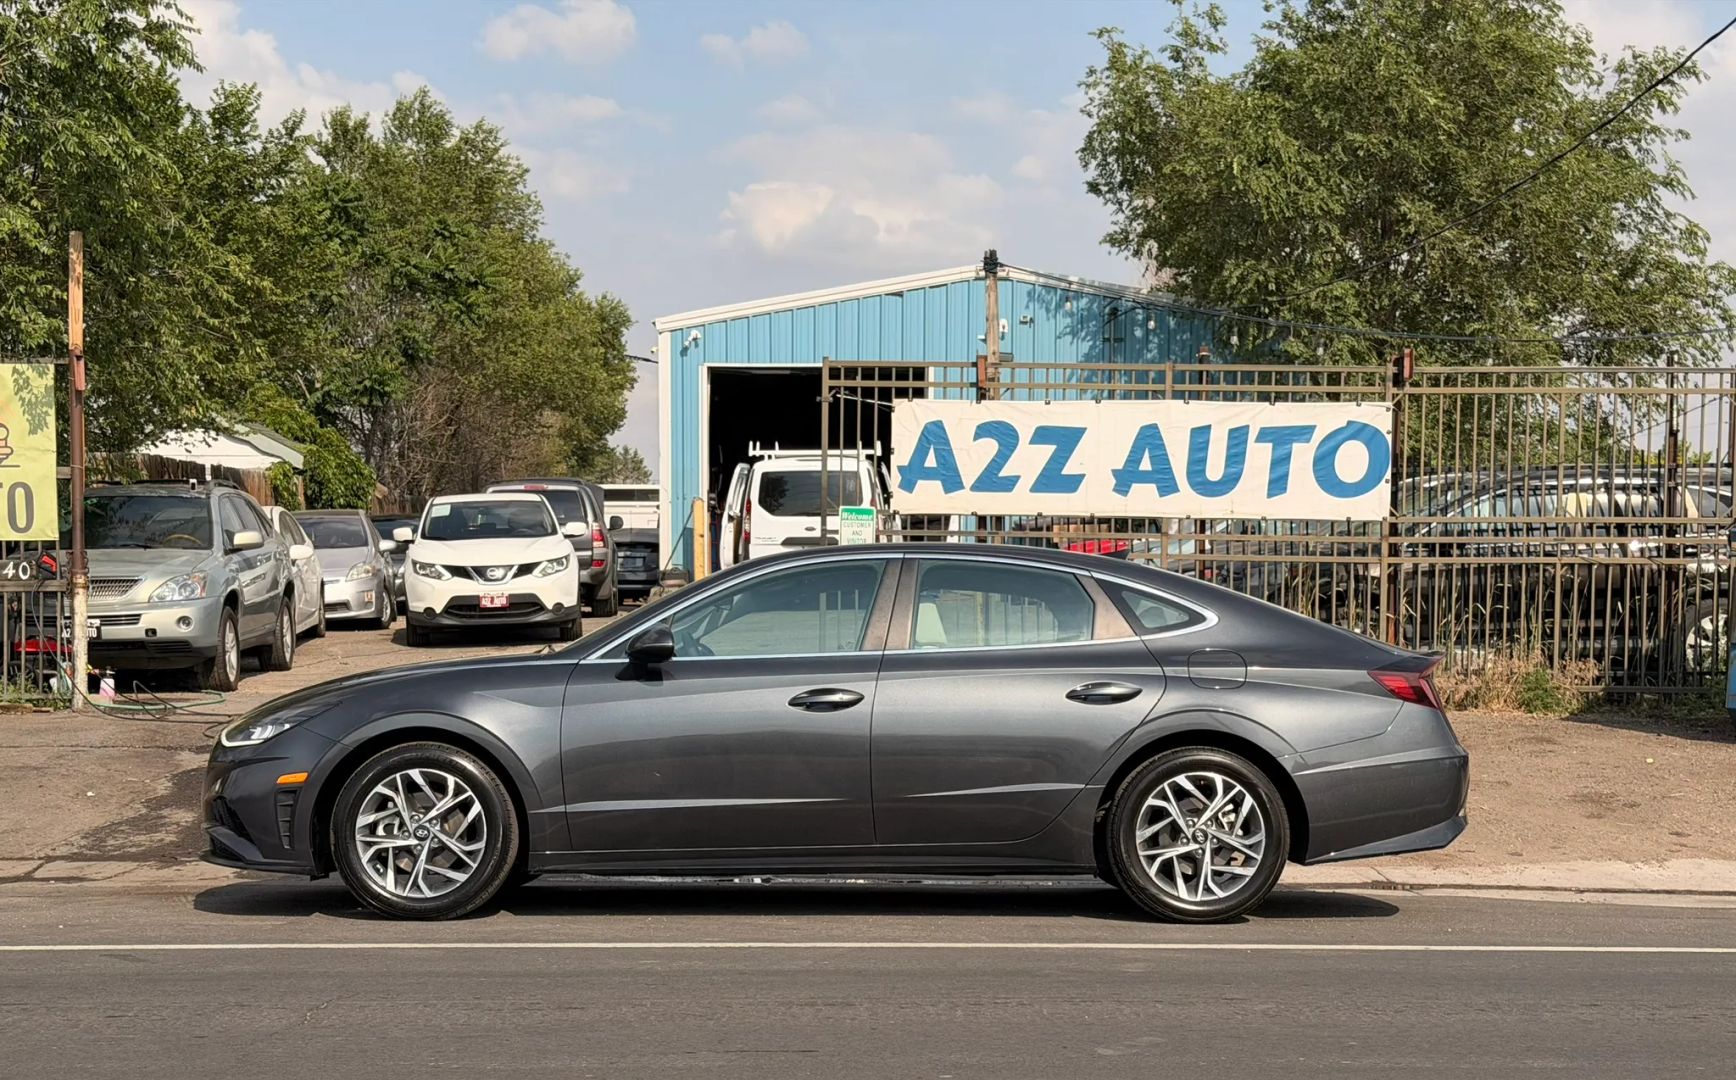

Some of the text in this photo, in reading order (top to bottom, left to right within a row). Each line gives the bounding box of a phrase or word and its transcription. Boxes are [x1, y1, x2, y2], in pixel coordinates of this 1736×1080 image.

[896, 419, 1391, 499] A2Z AUTO
[0, 481, 34, 534] O
[841, 511, 873, 520] Welcome
[2, 561, 31, 580] 40
